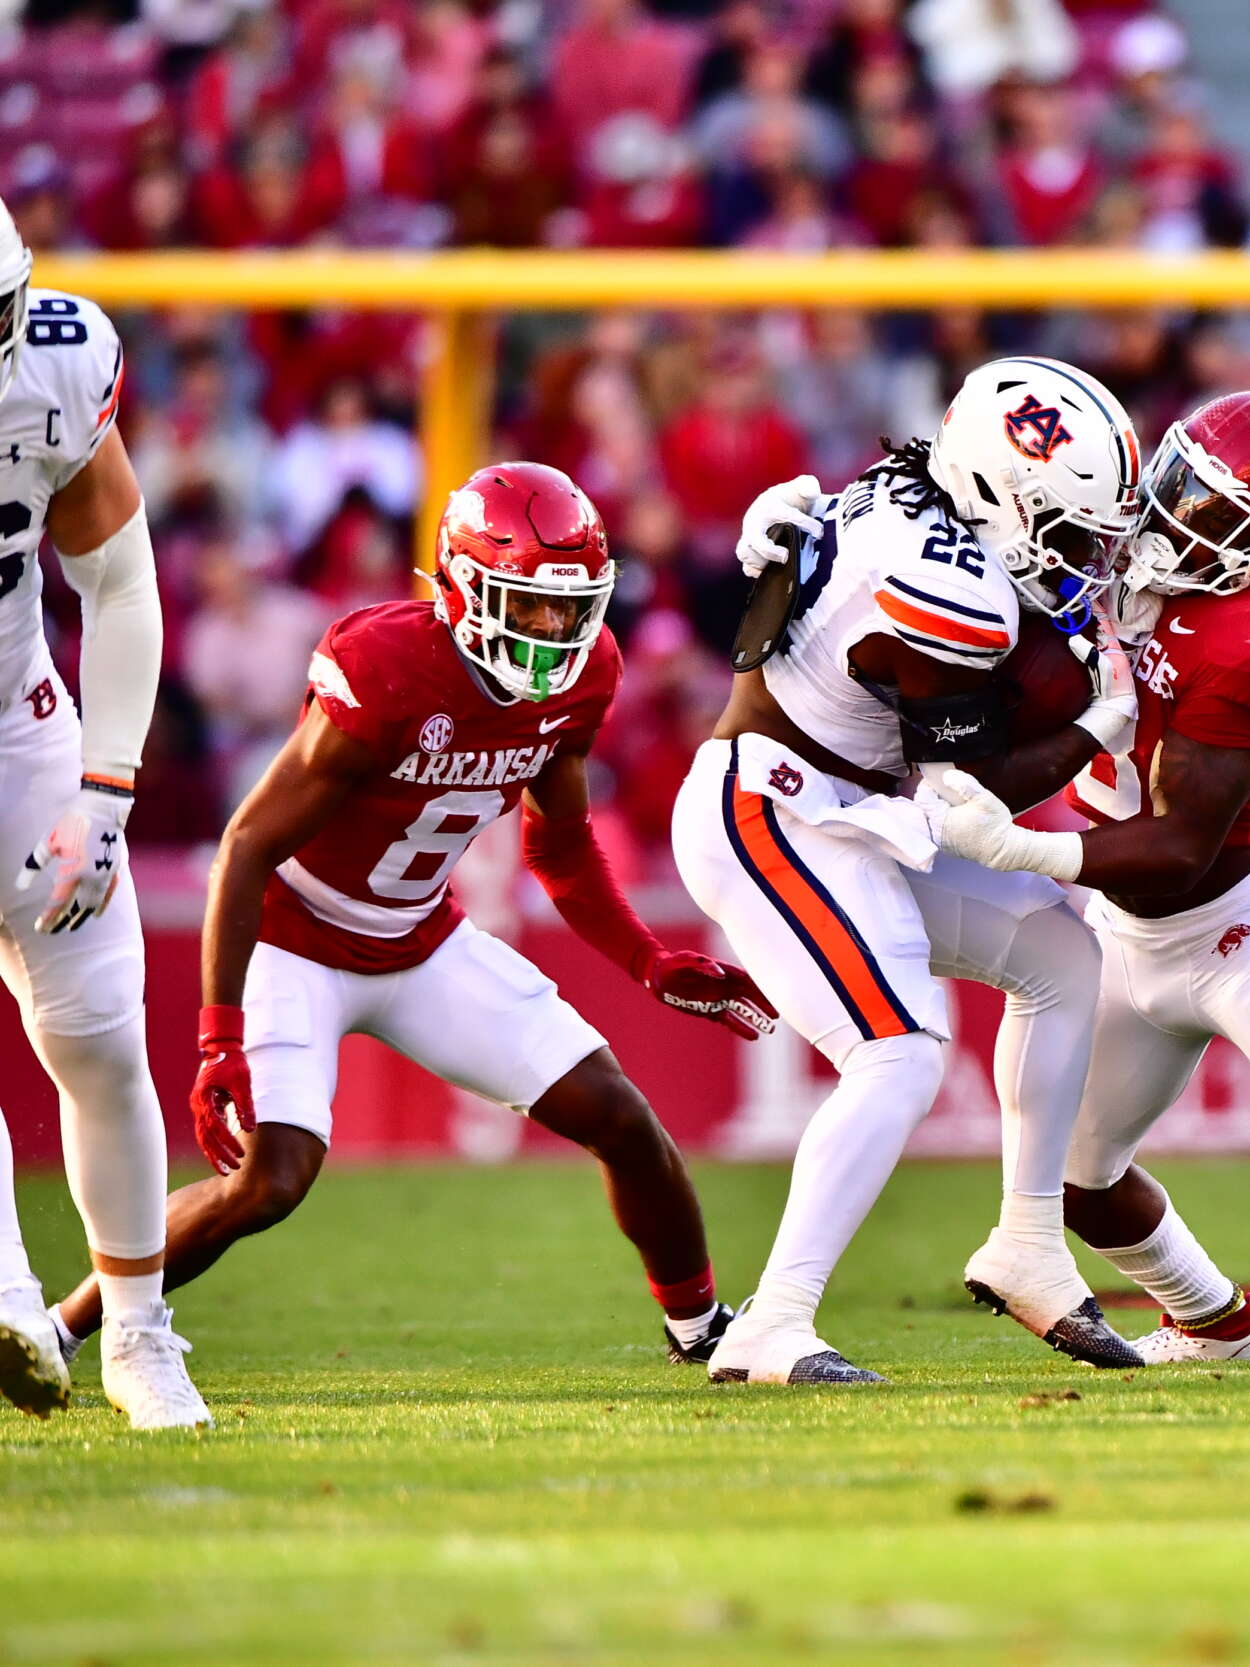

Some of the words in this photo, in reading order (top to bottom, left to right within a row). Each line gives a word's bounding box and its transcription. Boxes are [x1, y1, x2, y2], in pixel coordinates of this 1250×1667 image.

[46, 408, 61, 446] C
[920, 522, 986, 580] 22
[551, 567, 579, 577] HOGS
[420, 716, 452, 752] SEC
[943, 724, 979, 737] Douglas
[368, 789, 505, 901] 8
